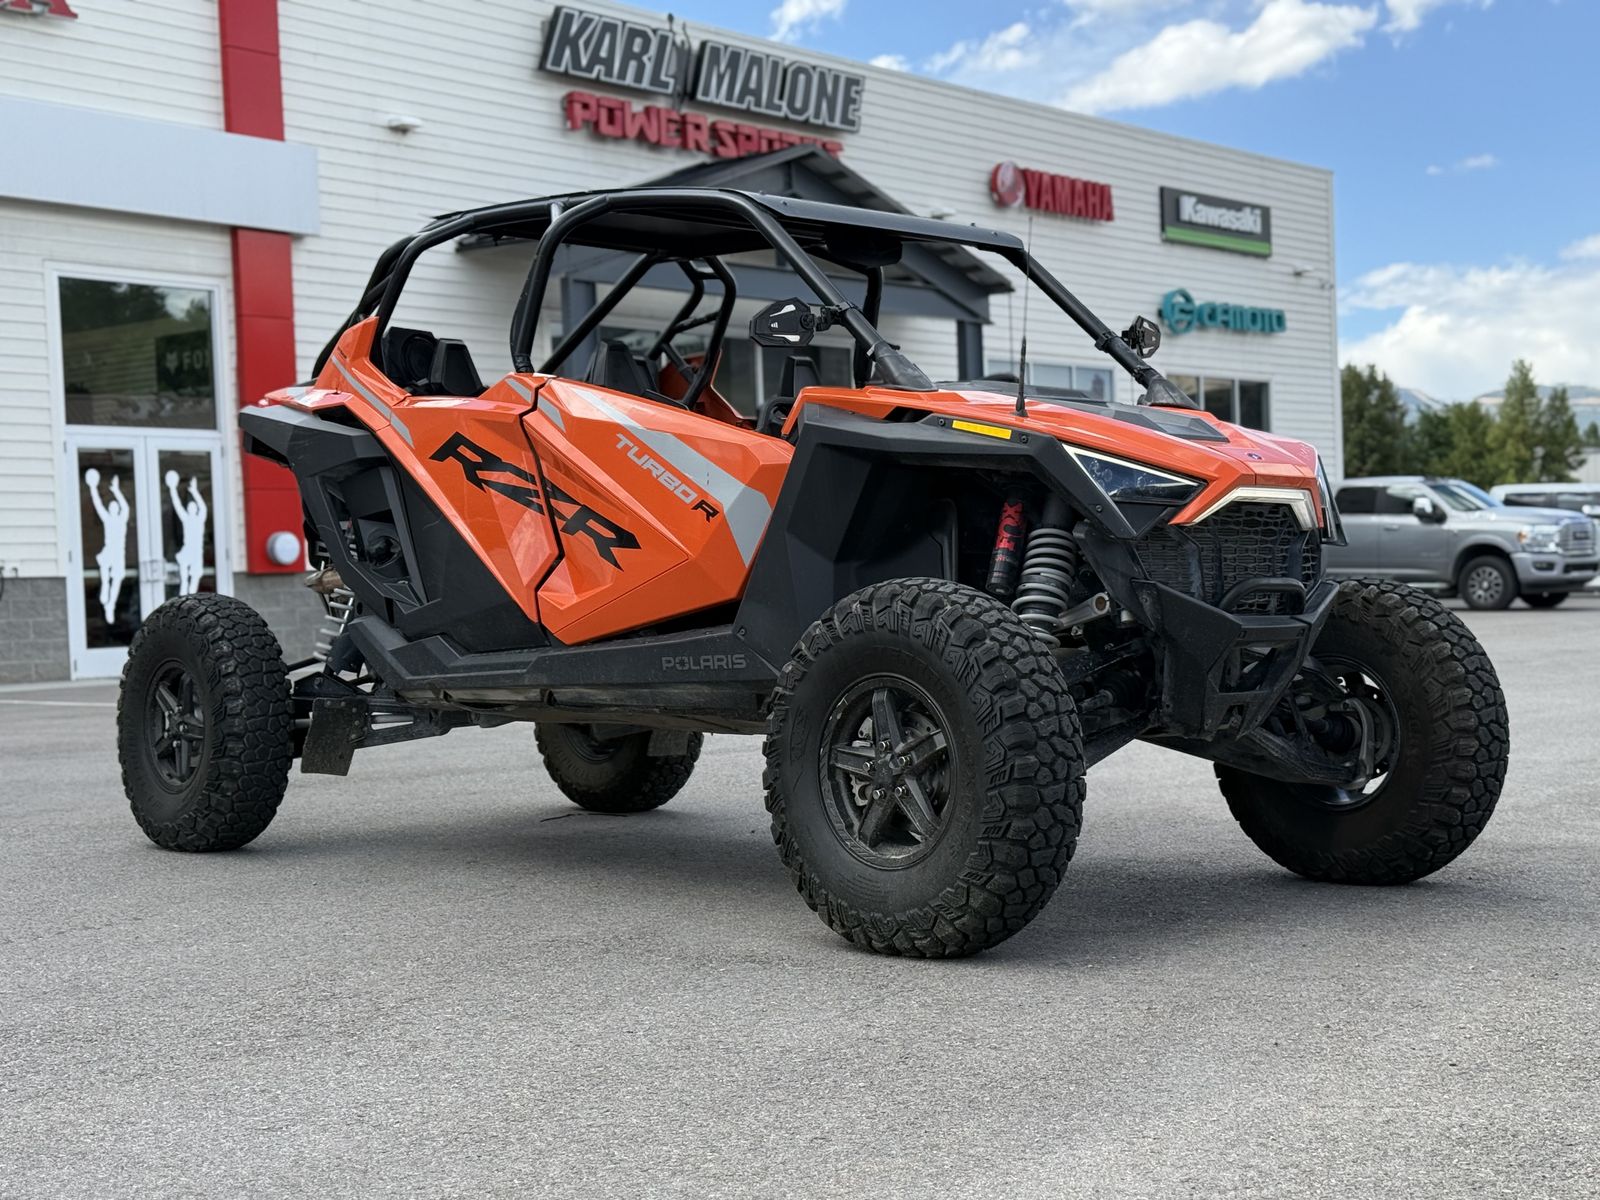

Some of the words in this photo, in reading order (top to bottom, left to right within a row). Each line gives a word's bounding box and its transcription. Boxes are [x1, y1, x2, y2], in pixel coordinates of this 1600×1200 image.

[542, 7, 676, 95] KARL
[697, 40, 866, 132] MALONE
[1022, 168, 1115, 222] YAMAHA
[1178, 194, 1263, 235] Kawasaki
[428, 431, 642, 572] RZR
[615, 432, 698, 505] TURBO
[690, 499, 720, 523] R
[661, 653, 748, 671] POLARIS
